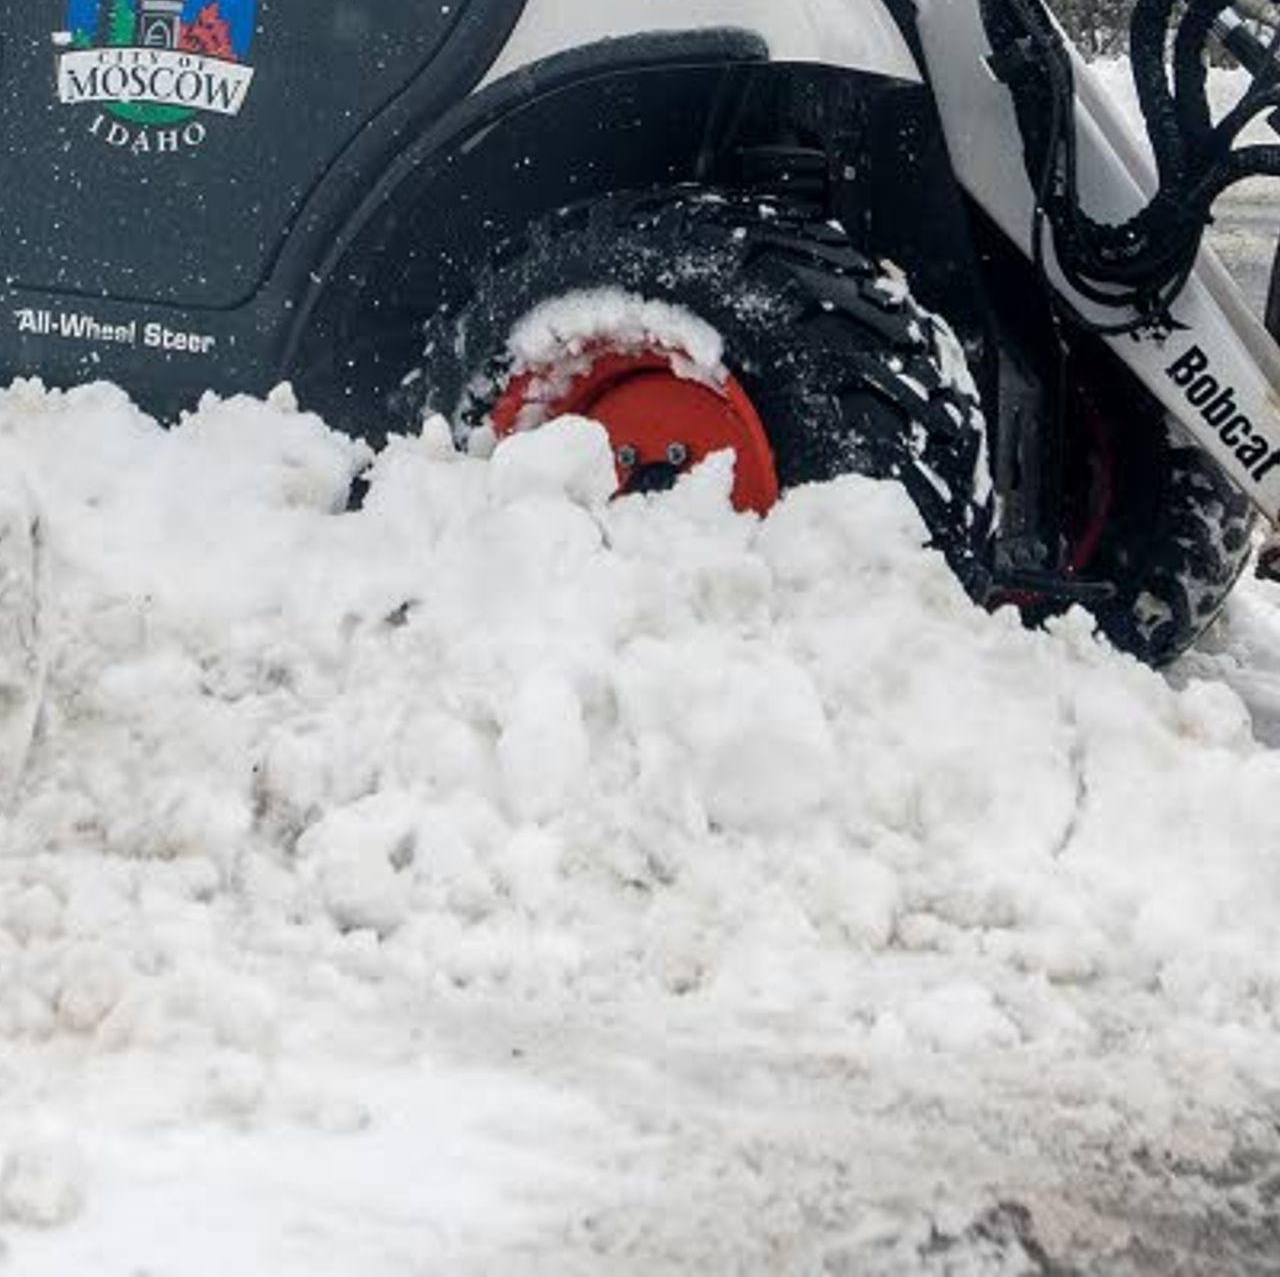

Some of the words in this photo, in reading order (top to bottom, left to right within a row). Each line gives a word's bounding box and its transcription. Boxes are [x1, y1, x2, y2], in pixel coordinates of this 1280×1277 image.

[67, 66, 241, 111] MOSCOW
[89, 114, 206, 152] IDAHO
[14, 308, 136, 345] All-Wheel
[143, 322, 216, 354] Steer
